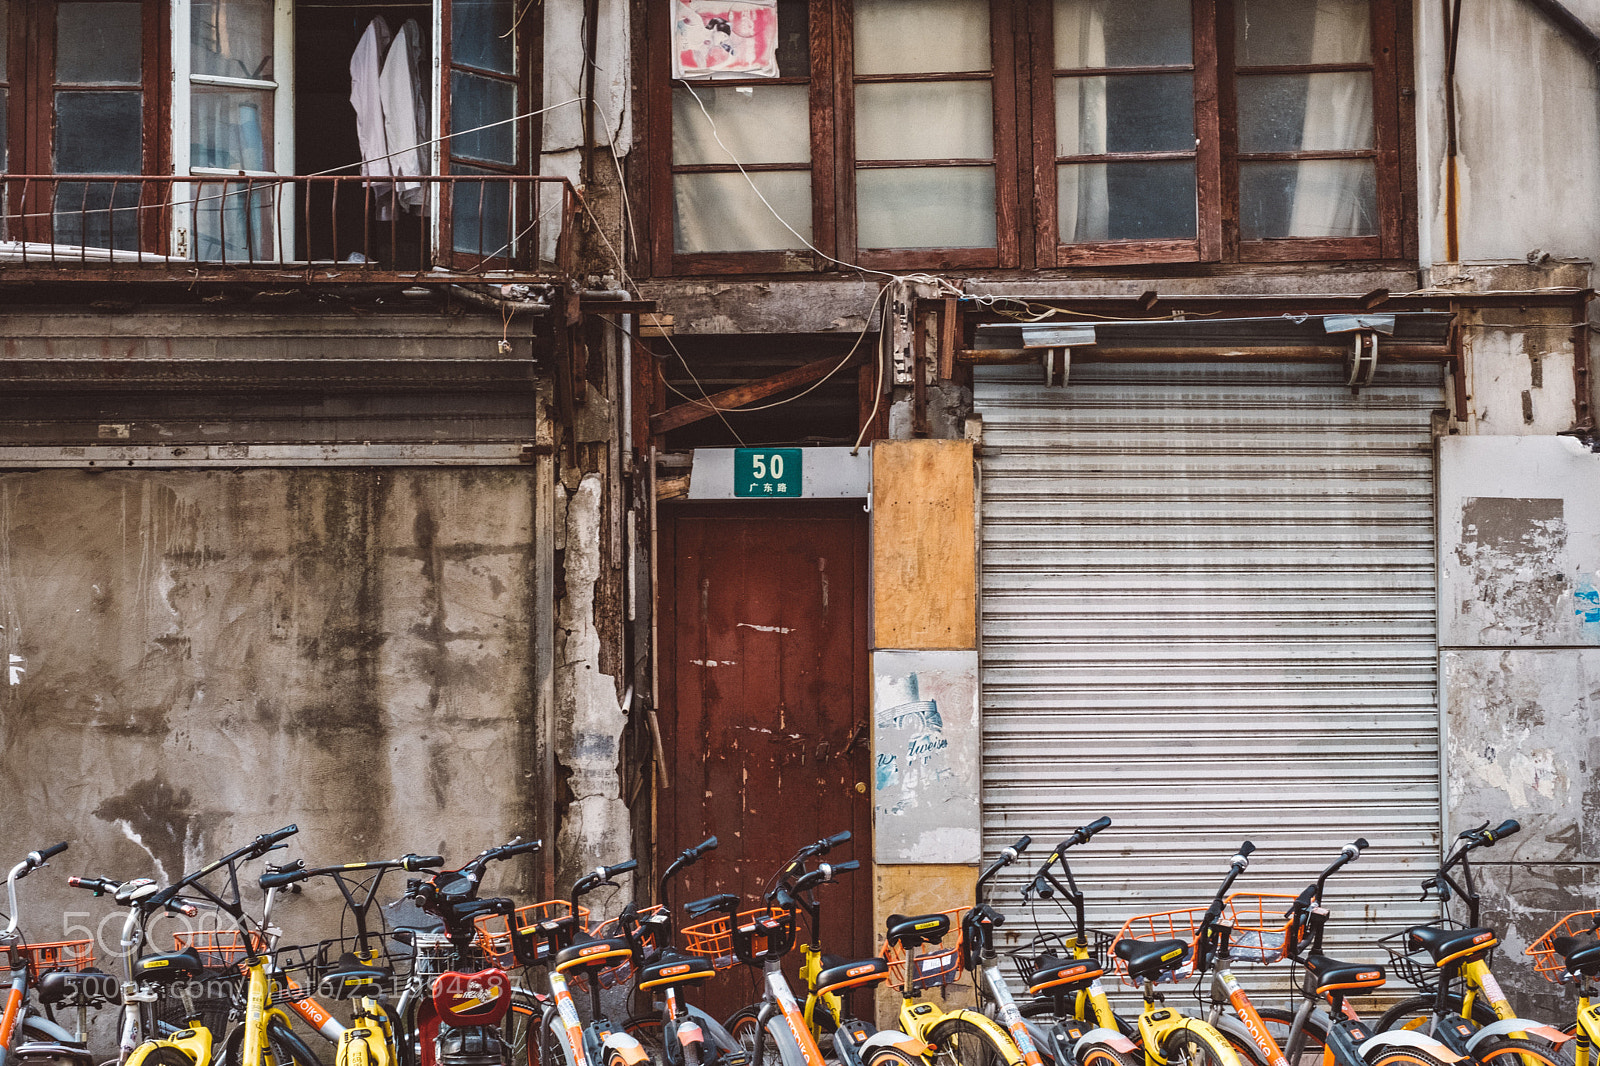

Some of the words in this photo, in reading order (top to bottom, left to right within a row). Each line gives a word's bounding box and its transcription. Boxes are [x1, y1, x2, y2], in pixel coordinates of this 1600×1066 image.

[753, 454, 784, 479] 50
[749, 483, 787, 493] 广东路
[1237, 1008, 1271, 1057] mobike
